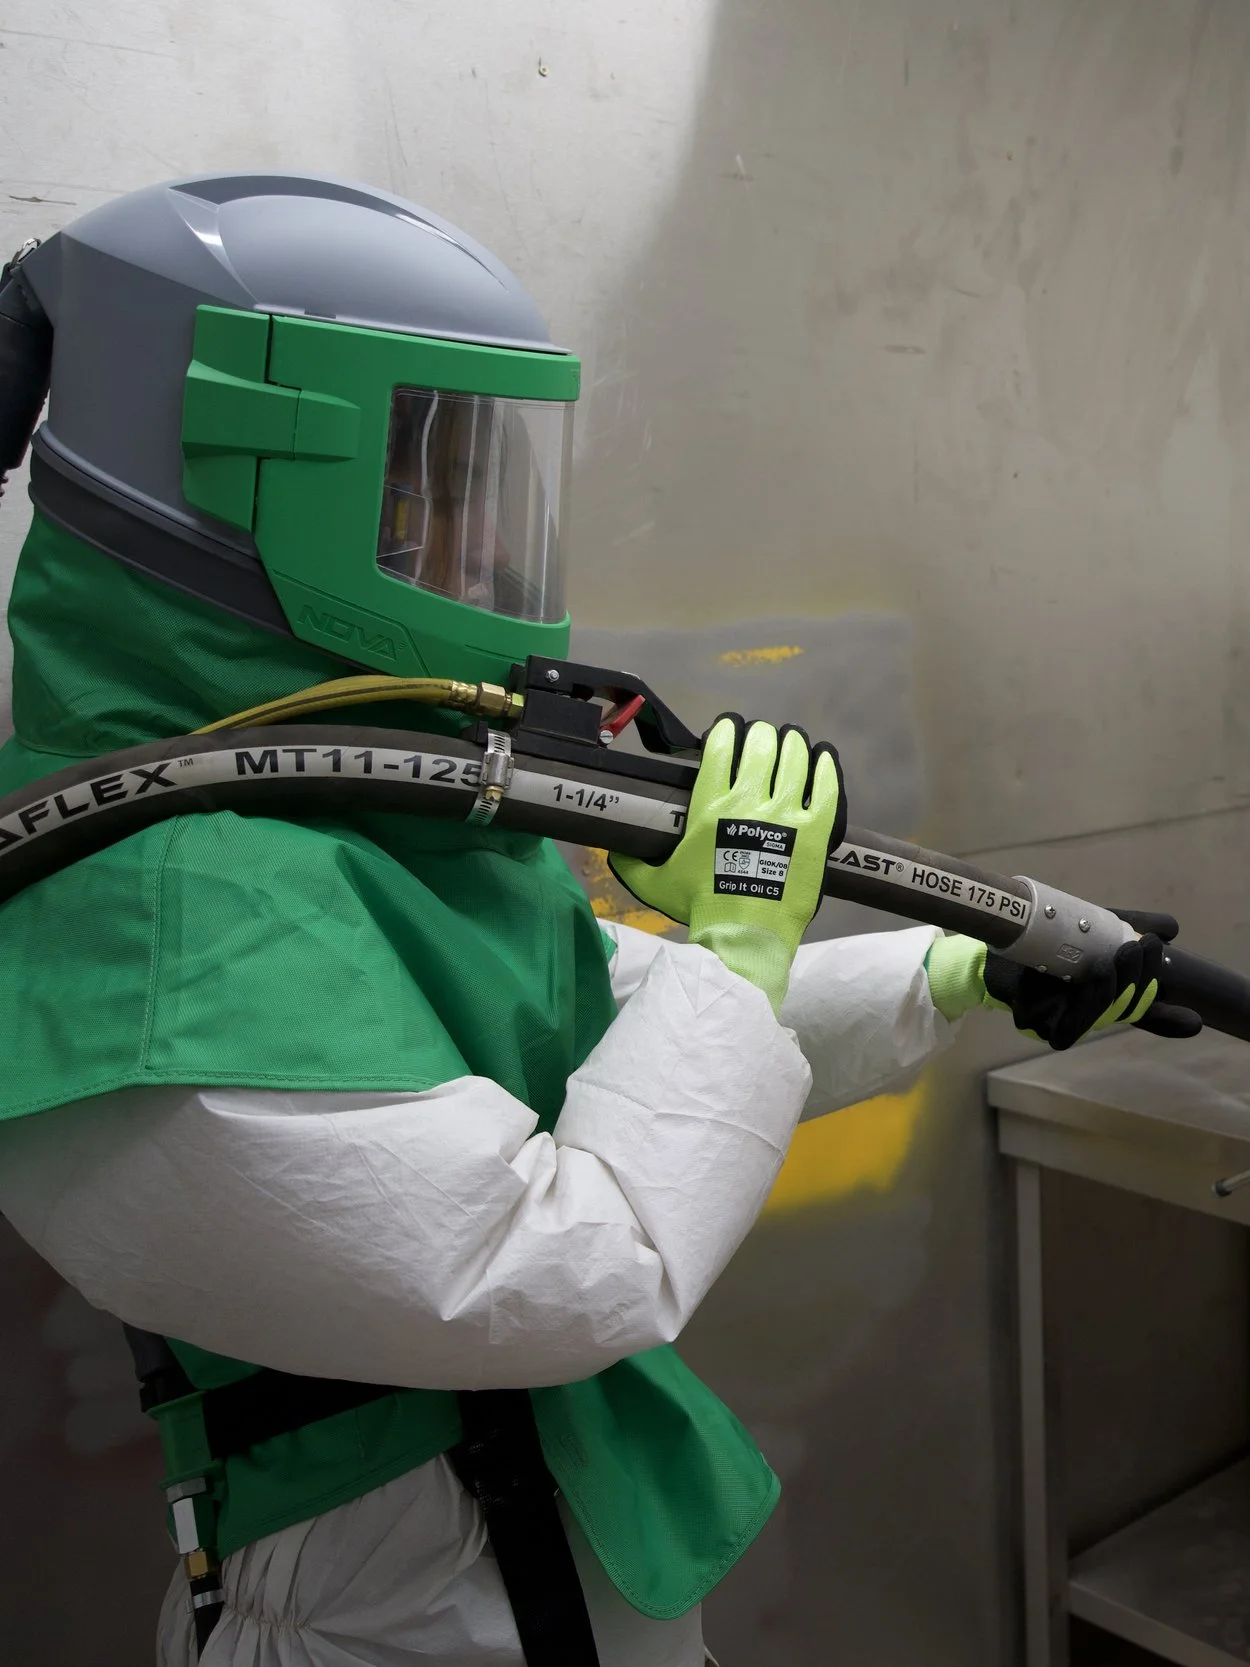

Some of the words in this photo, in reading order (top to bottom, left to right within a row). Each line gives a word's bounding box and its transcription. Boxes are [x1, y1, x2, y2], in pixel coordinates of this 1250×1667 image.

[296, 604, 397, 662] NOVA
[235, 748, 482, 787] MT11-125
[911, 867, 962, 897] HOSE
[968, 885, 995, 907] 175
[999, 896, 1026, 919] PSI
[719, 880, 737, 892] Grip
[739, 882, 747, 891] It
[750, 884, 764, 893] Oil
[766, 886, 780, 896] C5
[761, 867, 777, 875] Size
